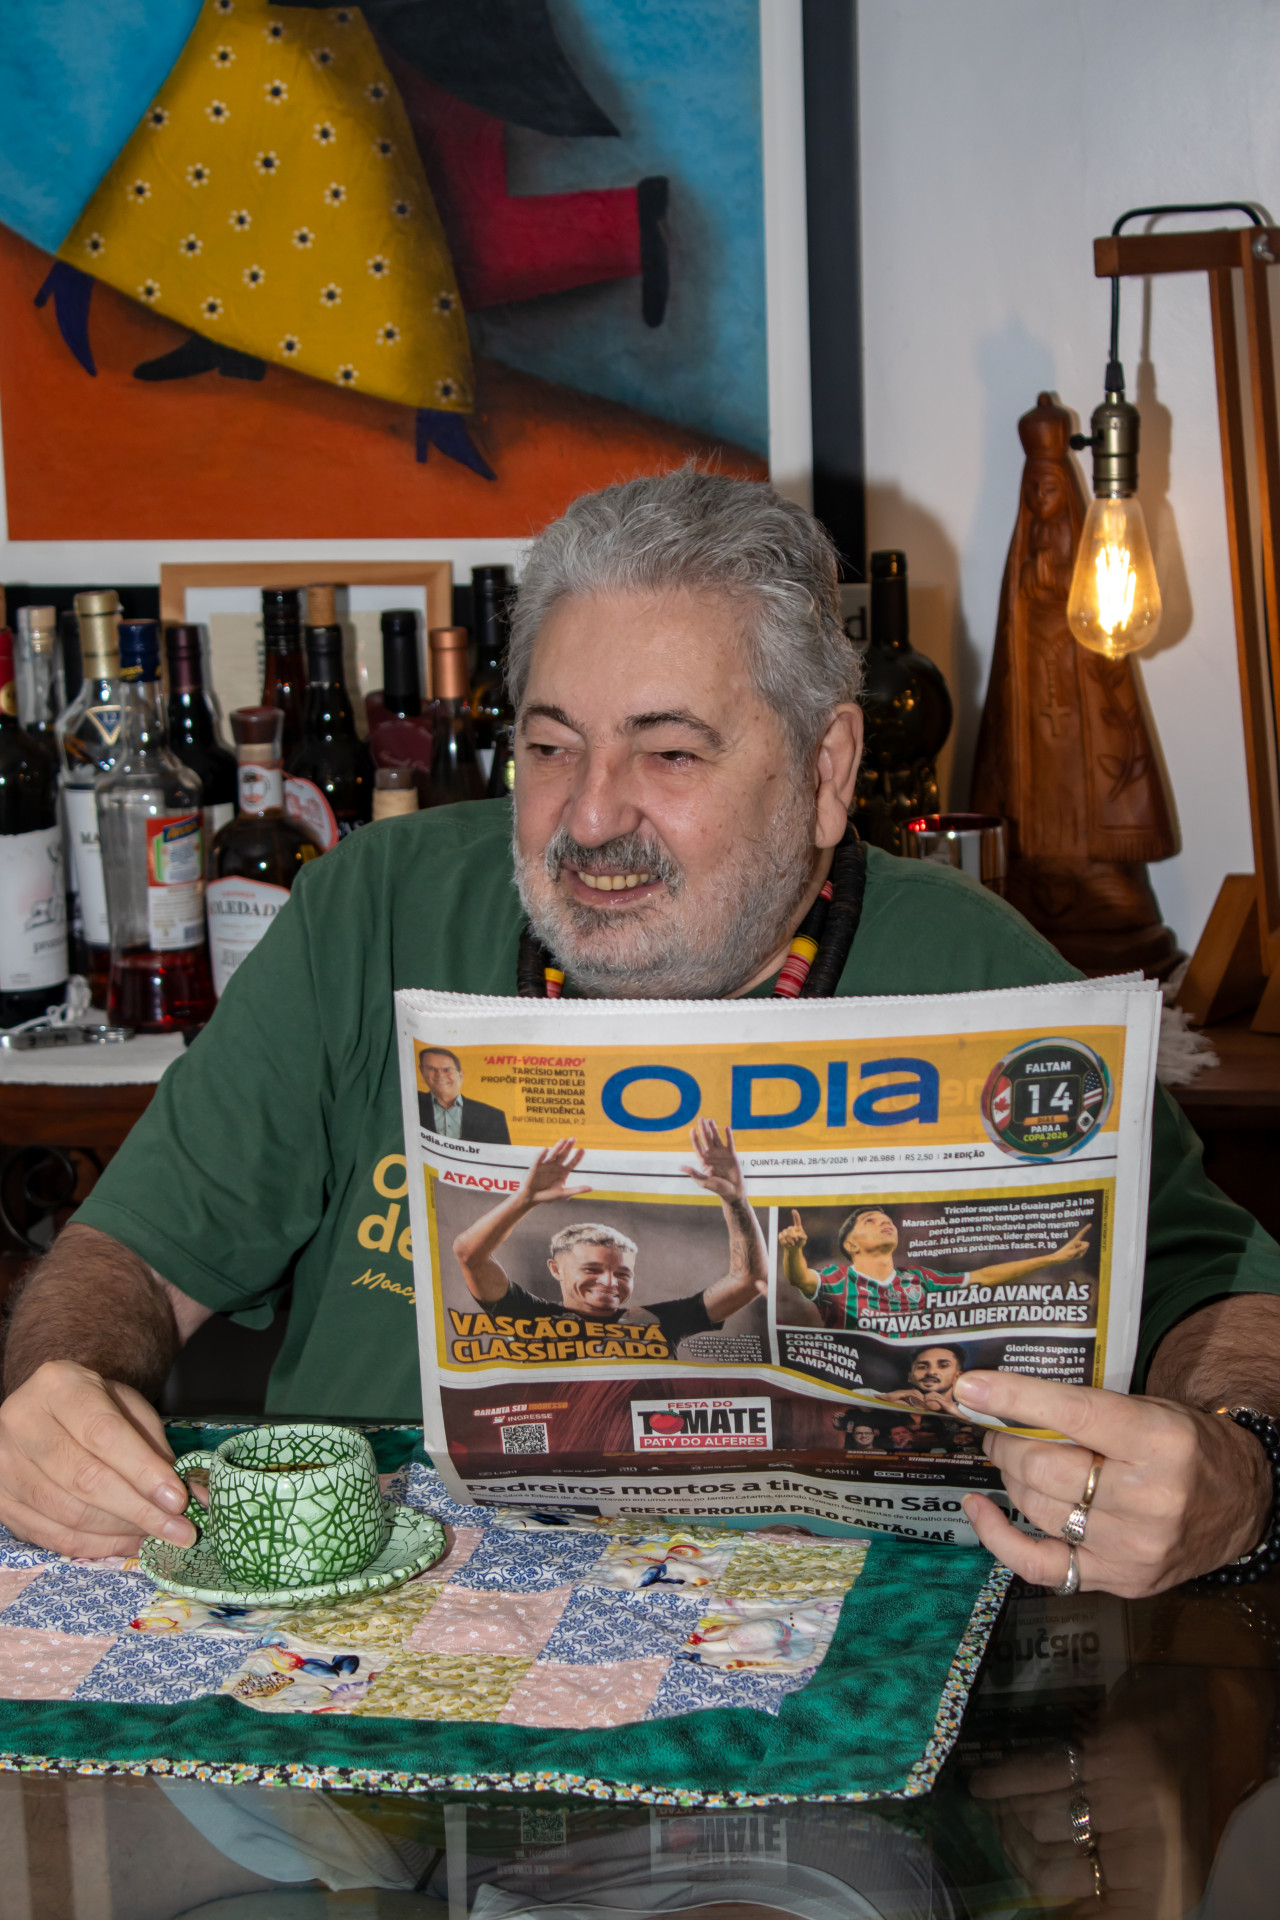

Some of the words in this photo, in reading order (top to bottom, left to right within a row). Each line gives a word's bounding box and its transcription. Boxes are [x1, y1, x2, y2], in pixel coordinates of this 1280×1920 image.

[512, 1067, 552, 1076] TARCÍSIO
[1025, 1061, 1071, 1074] FALTAM
[481, 1075, 517, 1083] PROPÕE
[519, 1077, 557, 1086] PROJETO
[522, 1087, 545, 1095] PARA
[601, 1064, 702, 1132] O
[1028, 1082, 1073, 1114] 14
[526, 1097, 571, 1105] RECURSOS
[526, 1105, 585, 1115] PREVIDÊNCIA
[1023, 1133, 1045, 1142] COPA
[1046, 1131, 1068, 1140] 2026
[1031, 1125, 1053, 1133] PARA
[420, 1131, 480, 1154] odia.com.br
[750, 1158, 806, 1166] QUINTA-FEIRA,
[808, 1156, 848, 1165] 28/5/2026
[869, 1154, 895, 1162] 26.988
[905, 1153, 915, 1161] R$
[917, 1154, 933, 1162] 2,50
[954, 1150, 985, 1160] EDIÇÃO
[443, 1170, 520, 1192] ATAQUE
[944, 1205, 977, 1215] Tricolor
[978, 1205, 1009, 1213] supera
[1009, 1203, 1020, 1211] La
[1021, 1201, 1050, 1211] Guaira
[1050, 1201, 1065, 1210] por
[1066, 1199, 1071, 1207] 3
[1078, 1198, 1083, 1206] 1
[1083, 1198, 1094, 1206] no
[902, 1217, 948, 1227] Maracanã,
[961, 1215, 993, 1223] mesmo
[995, 1214, 1024, 1222] tempo
[1040, 1212, 1056, 1221] que
[1064, 1207, 1094, 1218] Bolívar
[929, 1227, 954, 1237] perde
[955, 1226, 974, 1235] para
[982, 1221, 1026, 1231] Rivadavia
[1027, 1221, 1046, 1230] pelo
[1047, 1221, 1079, 1229] mesmo
[909, 1239, 938, 1248] placar.
[939, 1236, 949, 1246] Já
[957, 1233, 1002, 1244] Flamengo,
[1003, 1232, 1023, 1240] líder
[1024, 1231, 1049, 1241] geral,
[1050, 1230, 1068, 1239] terá
[907, 1248, 951, 1258] vantagem
[969, 1242, 1009, 1253] próximas
[1011, 1241, 1037, 1249] fases.
[1038, 1241, 1046, 1249] P.
[1047, 1241, 1057, 1249] 16
[926, 1283, 991, 1309] FLUZÃO
[994, 1284, 1063, 1305] AVANÇA
[1066, 1281, 1090, 1300] ÀS
[450, 1309, 580, 1338] VASCÃO
[585, 1322, 668, 1342] ESTÁ
[858, 1314, 931, 1333] OITAVAS
[934, 1312, 957, 1329] DA
[960, 1305, 1088, 1326] LIBERTADORES
[785, 1333, 834, 1341] FOGÃO
[453, 1338, 669, 1362] CLASSIFICADO
[786, 1340, 859, 1360] CONFIRMA
[1005, 1344, 1045, 1353] Glorioso
[1046, 1346, 1078, 1354] supera
[799, 1347, 856, 1370] MELHOR
[1003, 1354, 1040, 1362] Caracas
[1059, 1356, 1065, 1364] 3
[787, 1354, 863, 1384] CAMPANHA
[1036, 1366, 1084, 1375] vantagem
[474, 1407, 510, 1416] GARANTA
[512, 1404, 527, 1412] SEU
[508, 1413, 552, 1422] INGRESSE
[644, 1437, 676, 1446] PATY
[681, 1438, 701, 1446] DO
[705, 1437, 764, 1446] ALFERES
[824, 1468, 861, 1477] AMSTEL
[466, 1482, 616, 1495] Pedreiros
[621, 1482, 736, 1496] mortos
[742, 1482, 761, 1493] a
[766, 1480, 839, 1500] tiros
[844, 1494, 894, 1509] em
[901, 1496, 961, 1512] São
[843, 1504, 892, 1517] ferramentas
[905, 1514, 942, 1522] trabalho
[619, 1506, 691, 1515] CRESCE
[693, 1504, 787, 1515] PROCURA
[790, 1505, 839, 1520] PELO
[842, 1510, 918, 1537] CARTÃO
[920, 1528, 955, 1543] JAÉ
